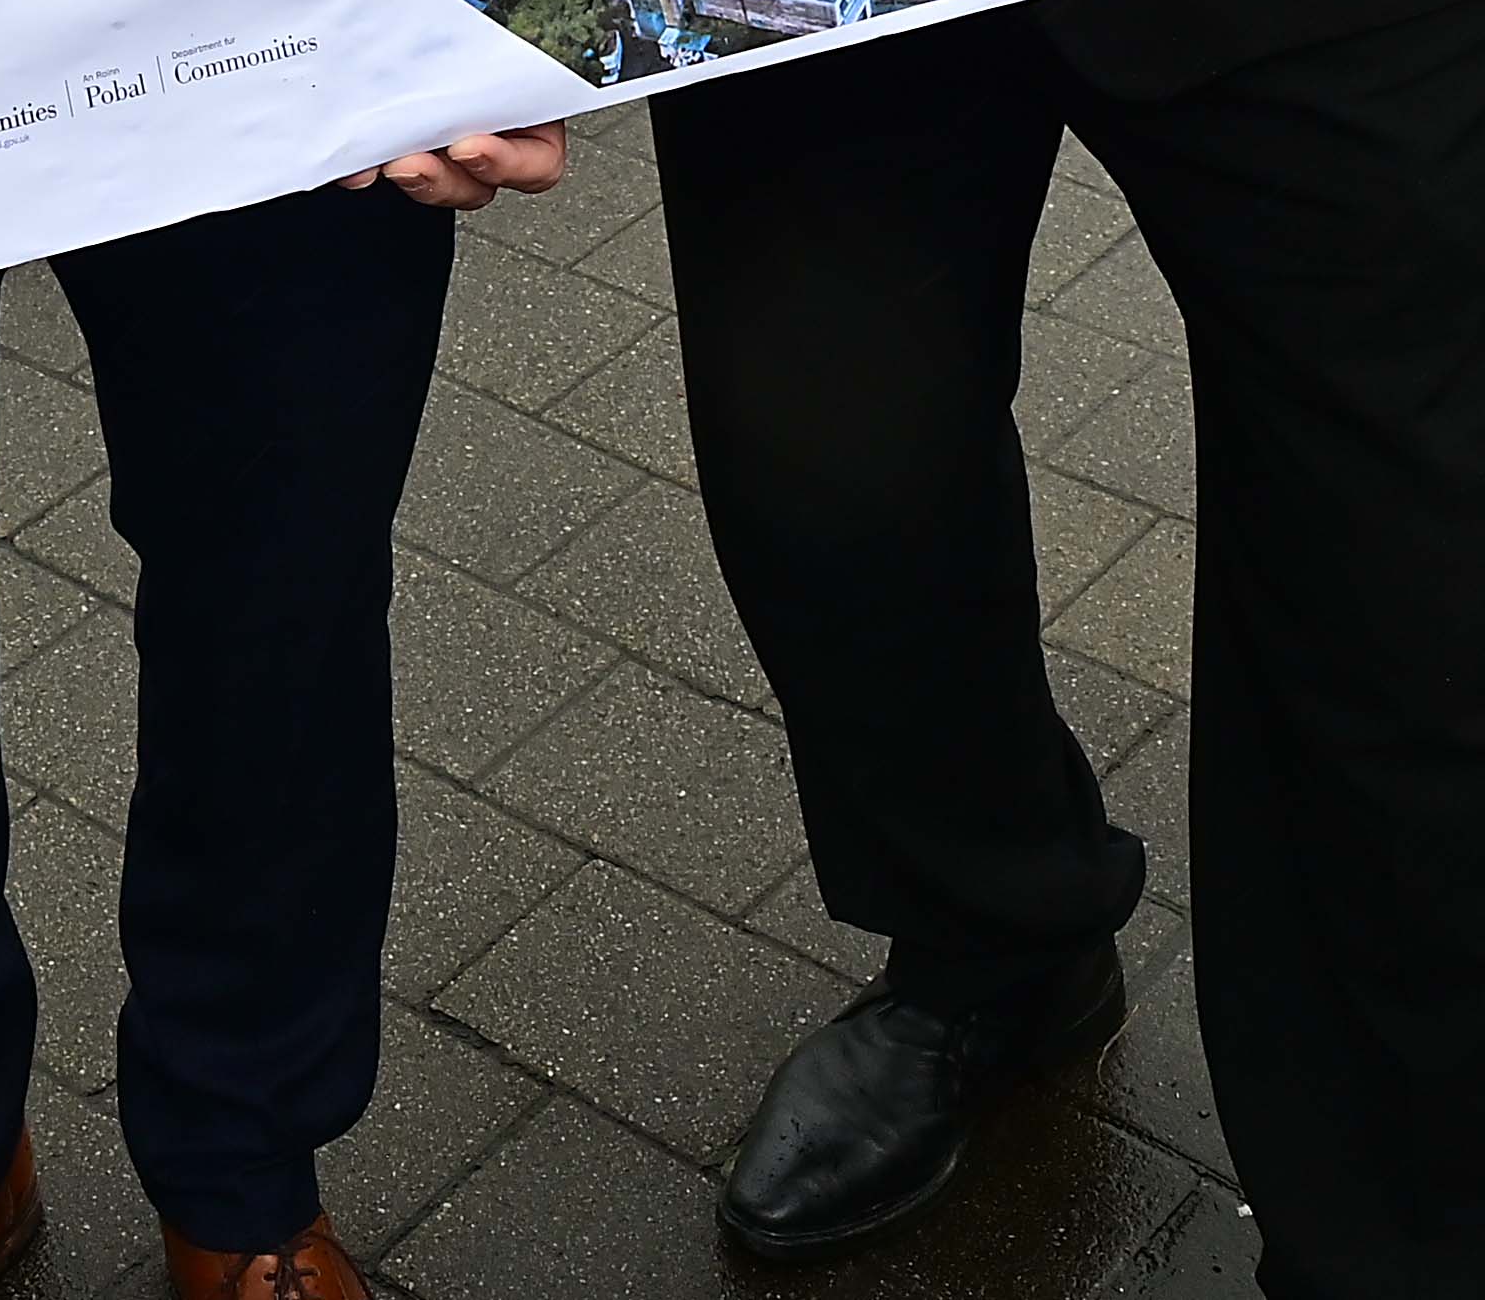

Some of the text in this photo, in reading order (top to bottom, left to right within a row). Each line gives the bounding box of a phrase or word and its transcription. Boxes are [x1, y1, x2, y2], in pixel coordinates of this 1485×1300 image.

[171, 36, 236, 60] Depairtment fur
[174, 34, 319, 85] Commonities
[82, 66, 121, 83] An Roinn
[85, 73, 148, 109] Pobal
